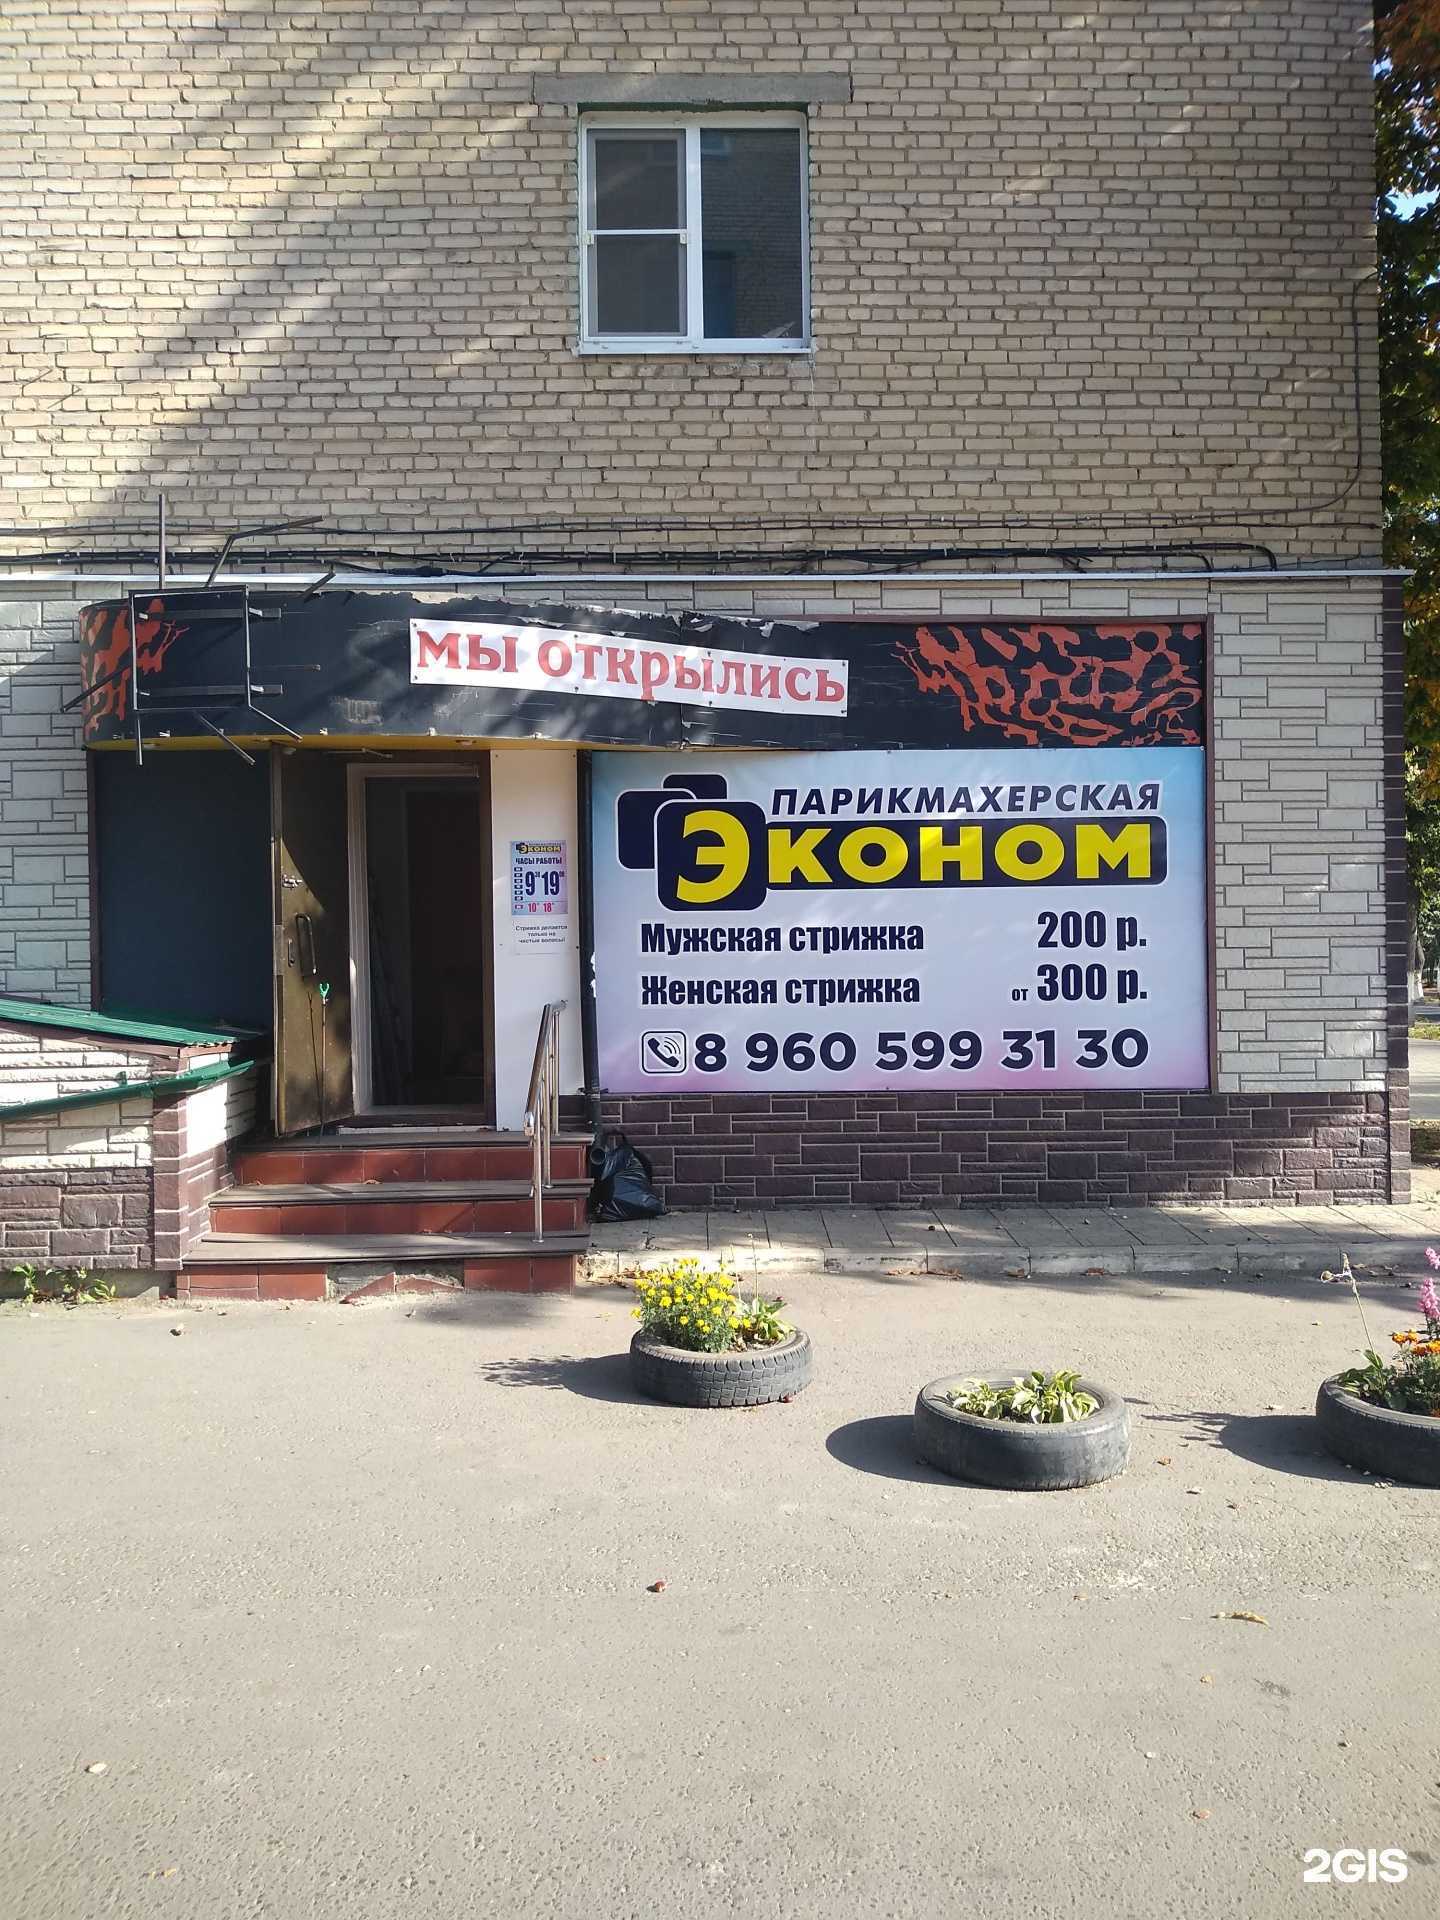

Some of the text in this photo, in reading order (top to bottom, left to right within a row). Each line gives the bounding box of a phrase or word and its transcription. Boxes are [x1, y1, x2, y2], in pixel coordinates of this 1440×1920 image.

[537, 638, 847, 702] открылись
[771, 783, 1161, 816] ПАРИКМАХЕРСКАЯ
[515, 857, 562, 865] ЧАСЫ РАБОТЫ
[641, 911, 1148, 956] Мужская стрижка 200 р.
[641, 963, 1148, 1007] Женская стрижка от 300 р.
[694, 1028, 1150, 1073] 8 960 599 31 30
